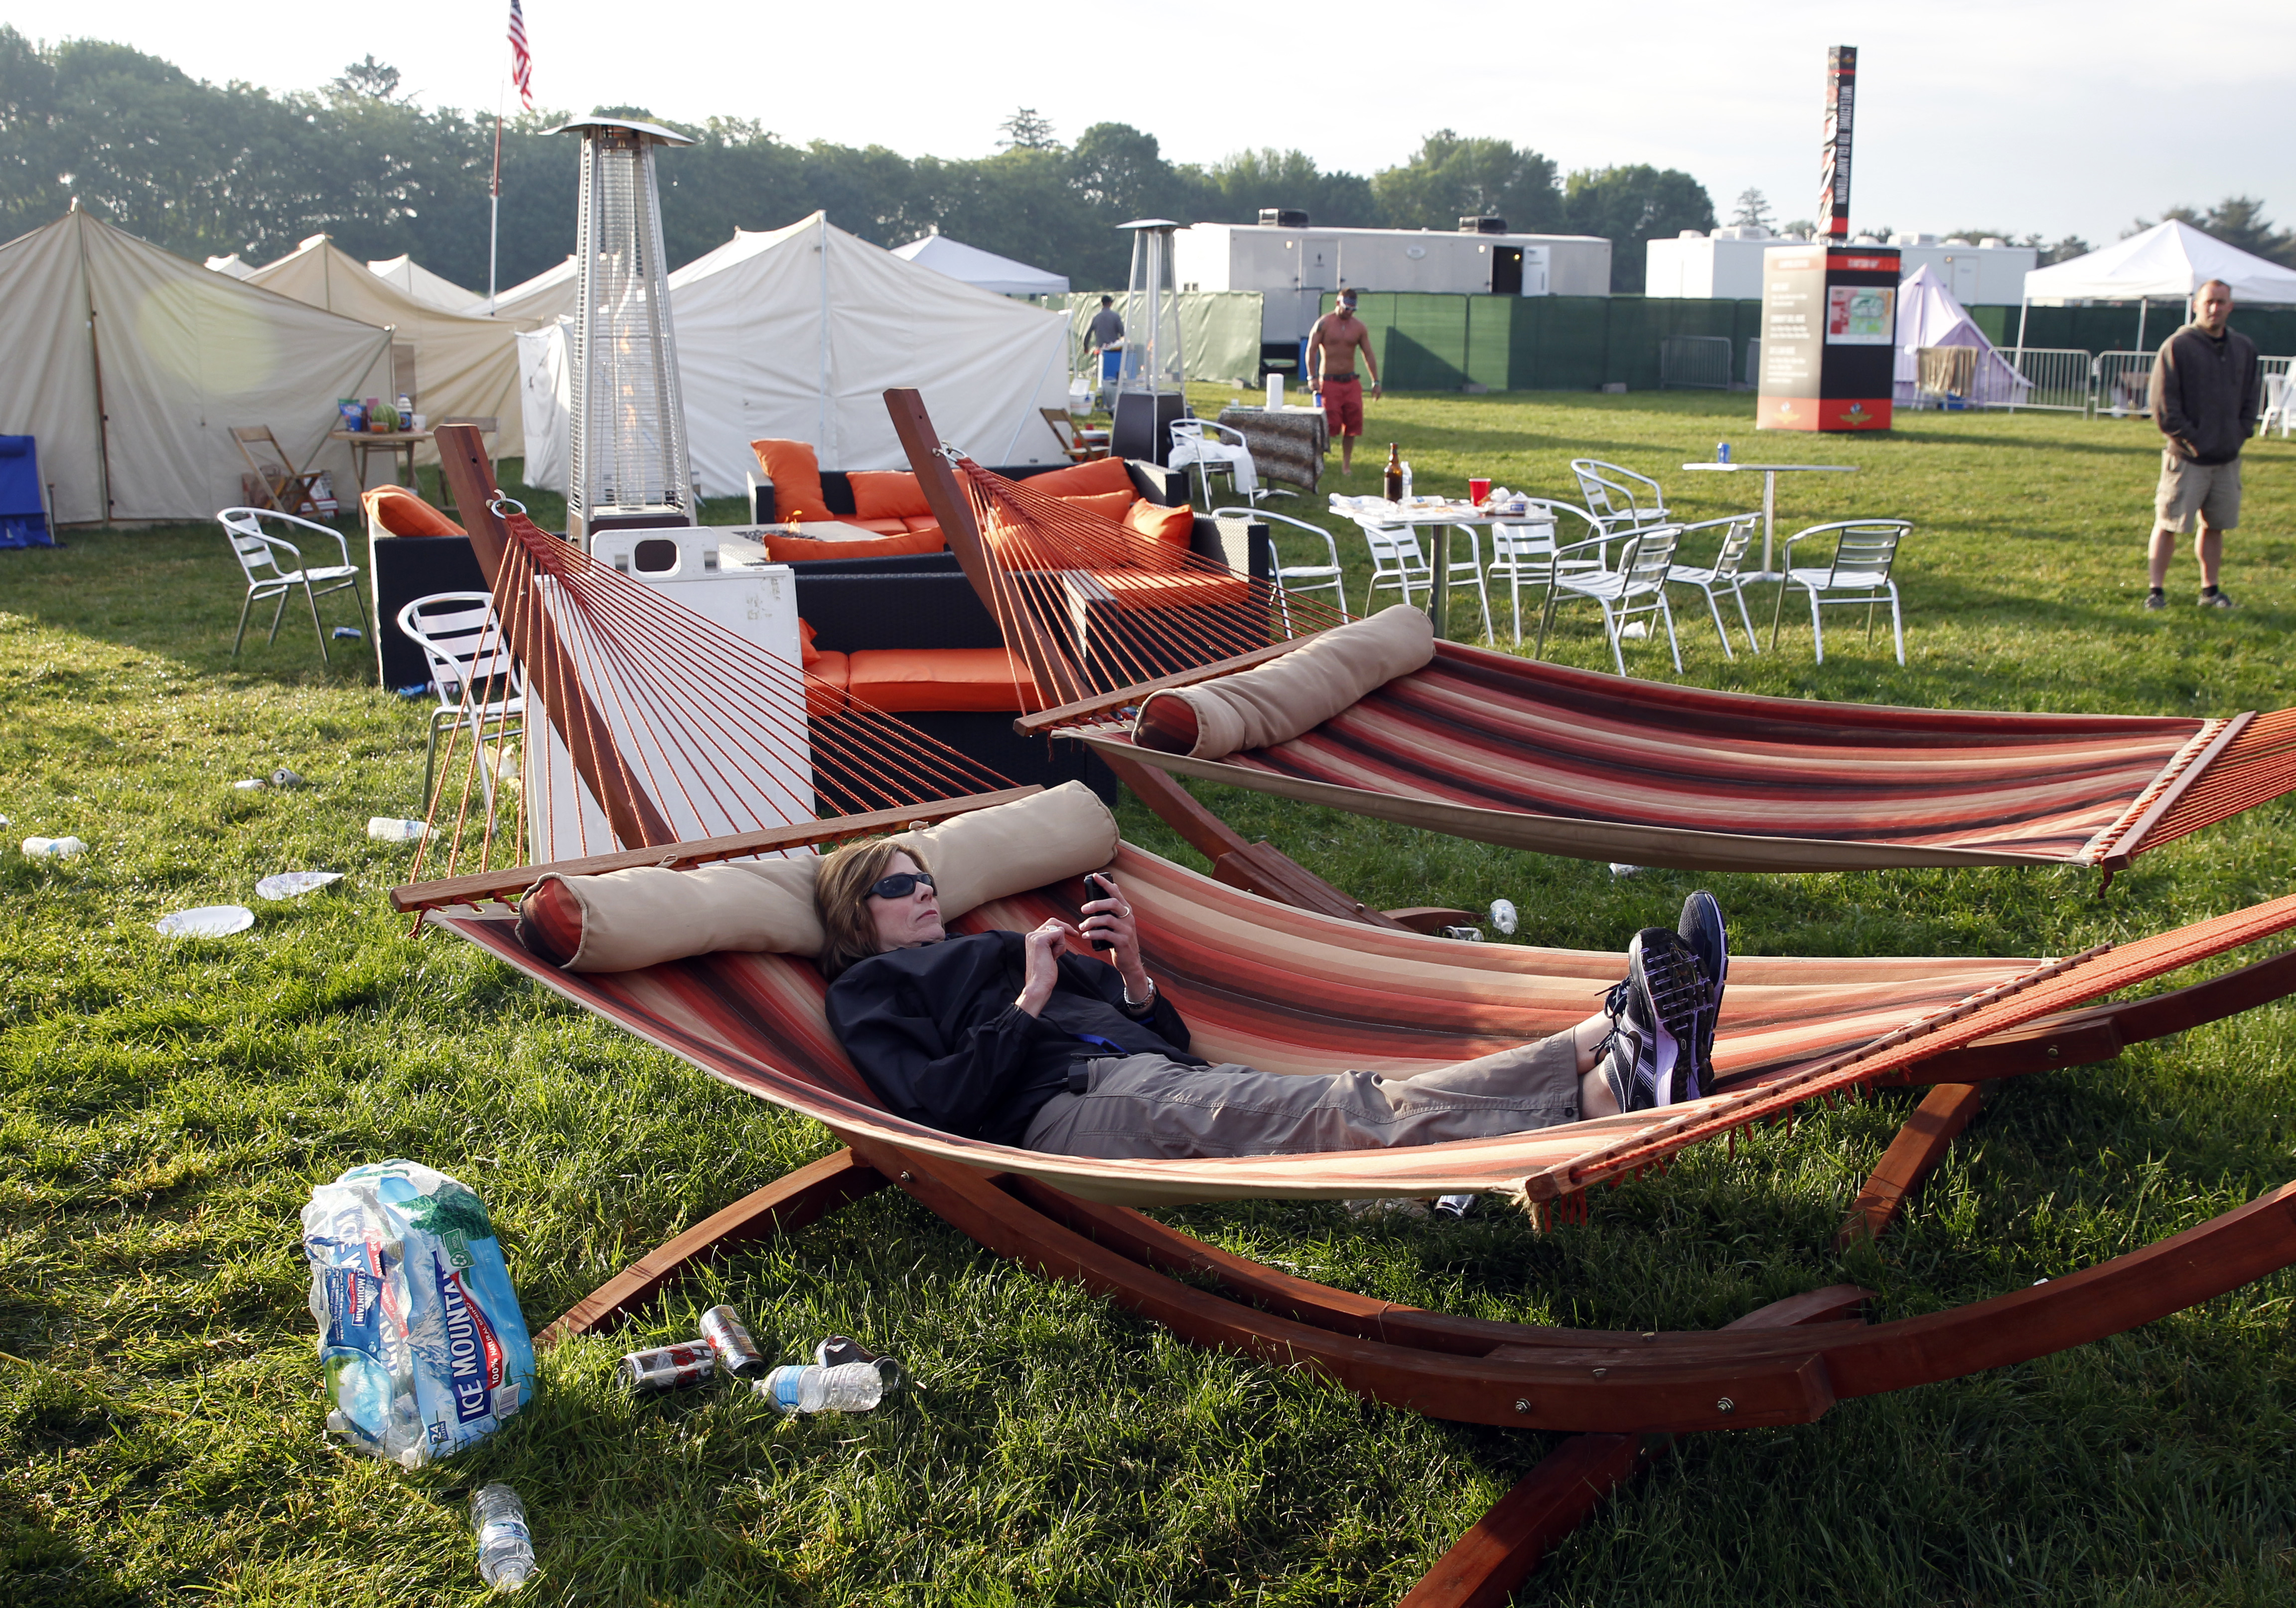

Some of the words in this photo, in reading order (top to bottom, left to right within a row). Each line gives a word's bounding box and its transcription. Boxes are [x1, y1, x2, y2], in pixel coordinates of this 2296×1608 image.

[1839, 85, 1853, 130] WELCOME
[1837, 133, 1851, 145] TO
[1834, 145, 1850, 204] GLAMPTOWN
[355, 1278, 366, 1322] MOUNTAIN
[466, 1302, 484, 1326] SPRING
[482, 1326, 498, 1356] NATURAL
[458, 1379, 484, 1416] ICE
[430, 1425, 441, 1443] 24
